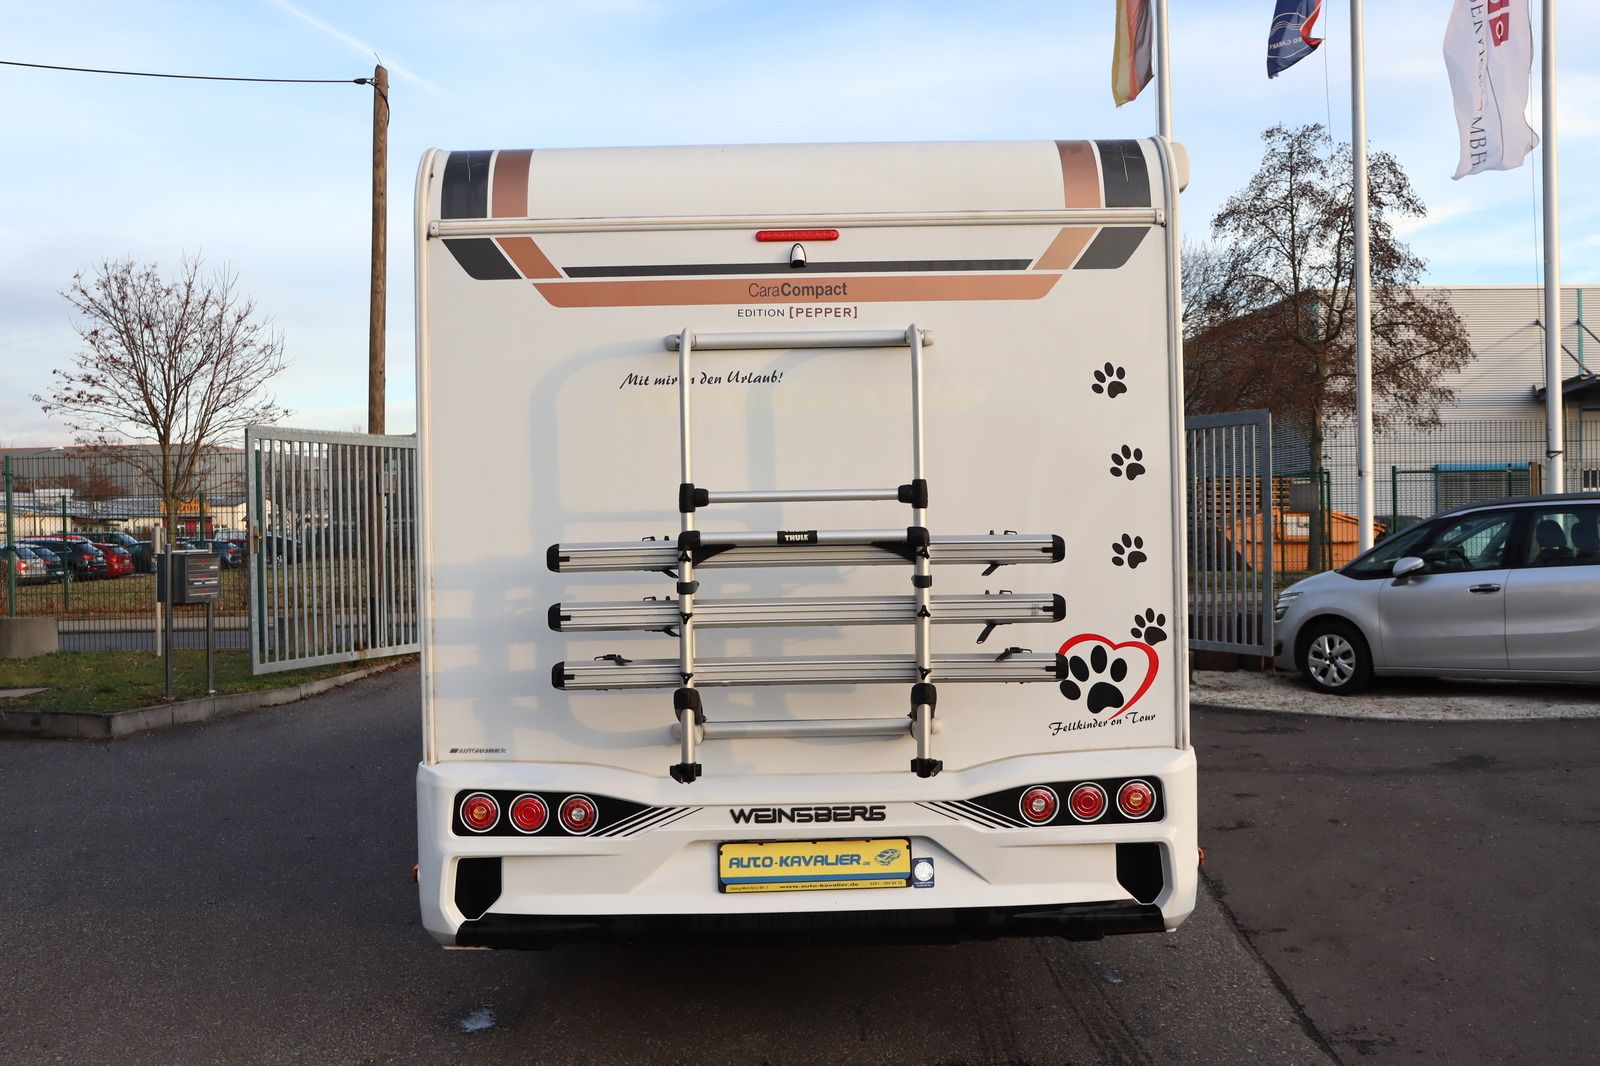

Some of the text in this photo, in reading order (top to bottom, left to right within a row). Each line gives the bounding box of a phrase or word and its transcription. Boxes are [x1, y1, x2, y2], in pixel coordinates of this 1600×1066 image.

[748, 282, 848, 299] CaraCompact
[737, 306, 858, 319] EDITION [PEPPER]
[619, 372, 650, 389] Mit
[653, 374, 678, 385] mir
[699, 371, 722, 385] den
[727, 369, 784, 385] Urlaub!
[1048, 711, 1156, 736] Fellkinder on Tour
[729, 805, 887, 824] WEINSBERG
